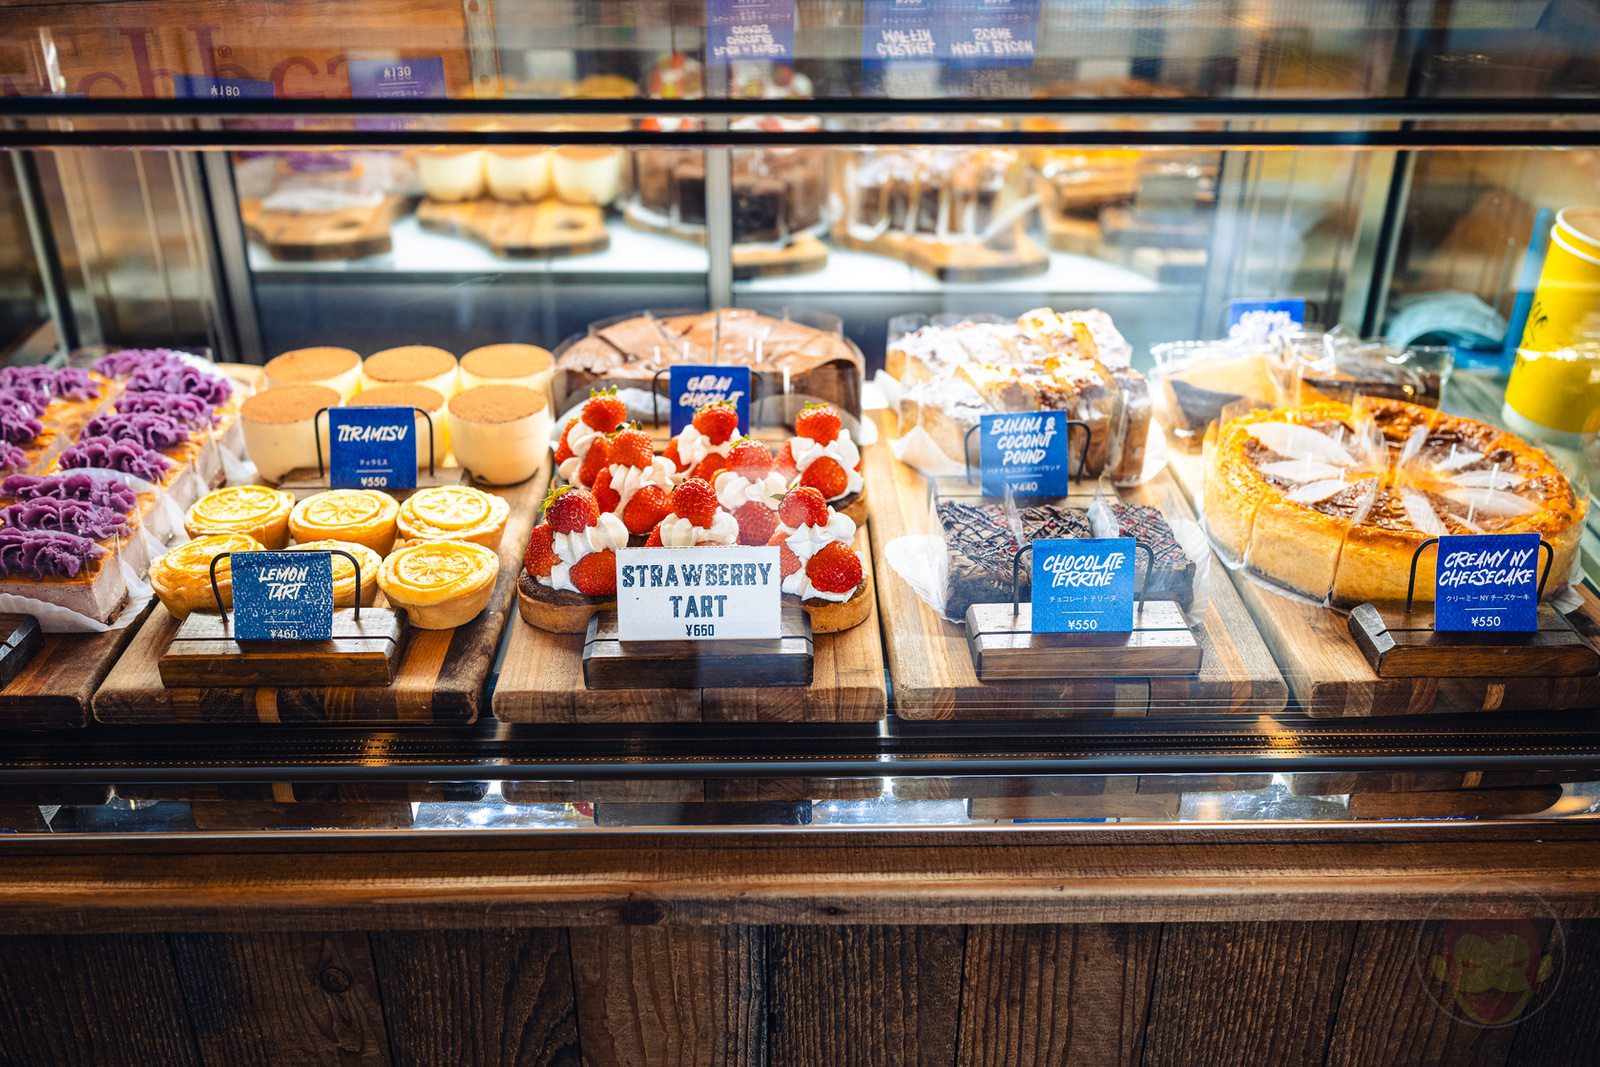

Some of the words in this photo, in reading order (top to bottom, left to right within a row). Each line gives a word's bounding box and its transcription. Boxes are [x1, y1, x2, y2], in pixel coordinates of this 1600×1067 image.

[337, 424, 408, 443] TIRAMISU
[989, 415, 1042, 435] BANANA
[996, 430, 1057, 450] COCONUT
[1002, 449, 1047, 467] POUND
[360, 476, 387, 488] ¥550
[1042, 552, 1126, 573] CHOCOLATE
[1443, 548, 1510, 569] CREAMY
[1509, 547, 1534, 568] NY
[258, 565, 309, 583] LEMON
[622, 562, 773, 588] STRAWBERRY
[1051, 569, 1116, 588] TERRINE
[1438, 567, 1535, 589] CHEESECAKE
[267, 582, 307, 601] TART
[668, 594, 728, 618] TART
[685, 624, 715, 637] ¥660
[1067, 619, 1098, 630] ¥550
[1471, 616, 1501, 627] ¥550
[269, 629, 299, 640] ¥460
